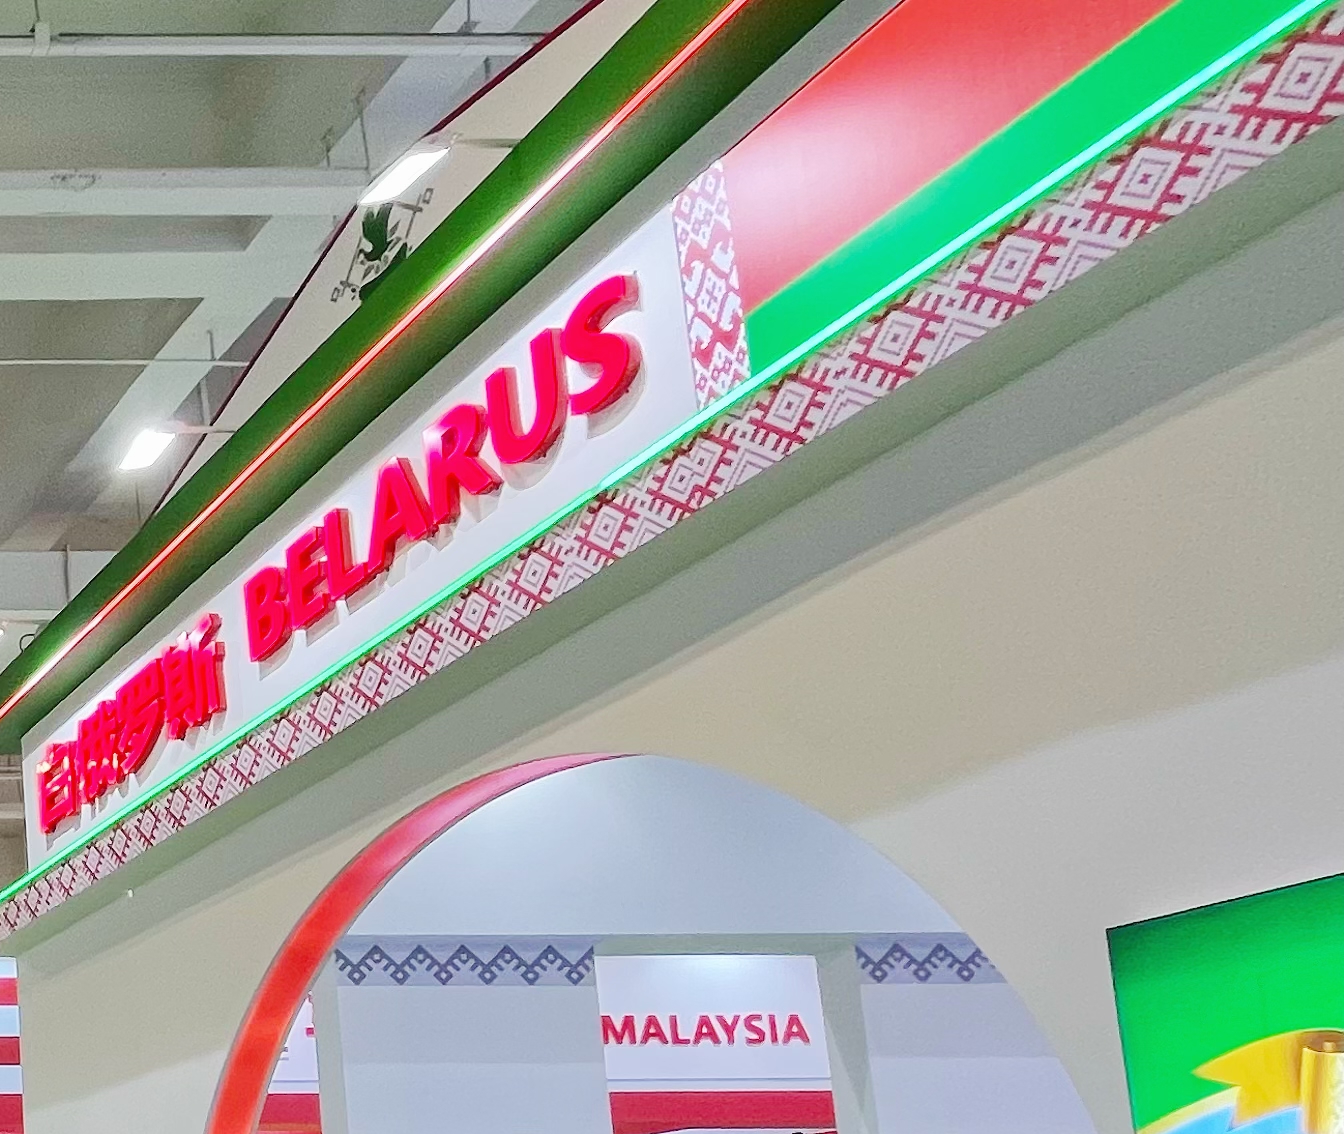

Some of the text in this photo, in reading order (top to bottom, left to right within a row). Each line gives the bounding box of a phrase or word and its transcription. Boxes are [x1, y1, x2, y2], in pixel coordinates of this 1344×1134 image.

[36, 272, 643, 834] 白俄罗斯 BELARUS
[601, 1013, 811, 1046] MALAYSIA
